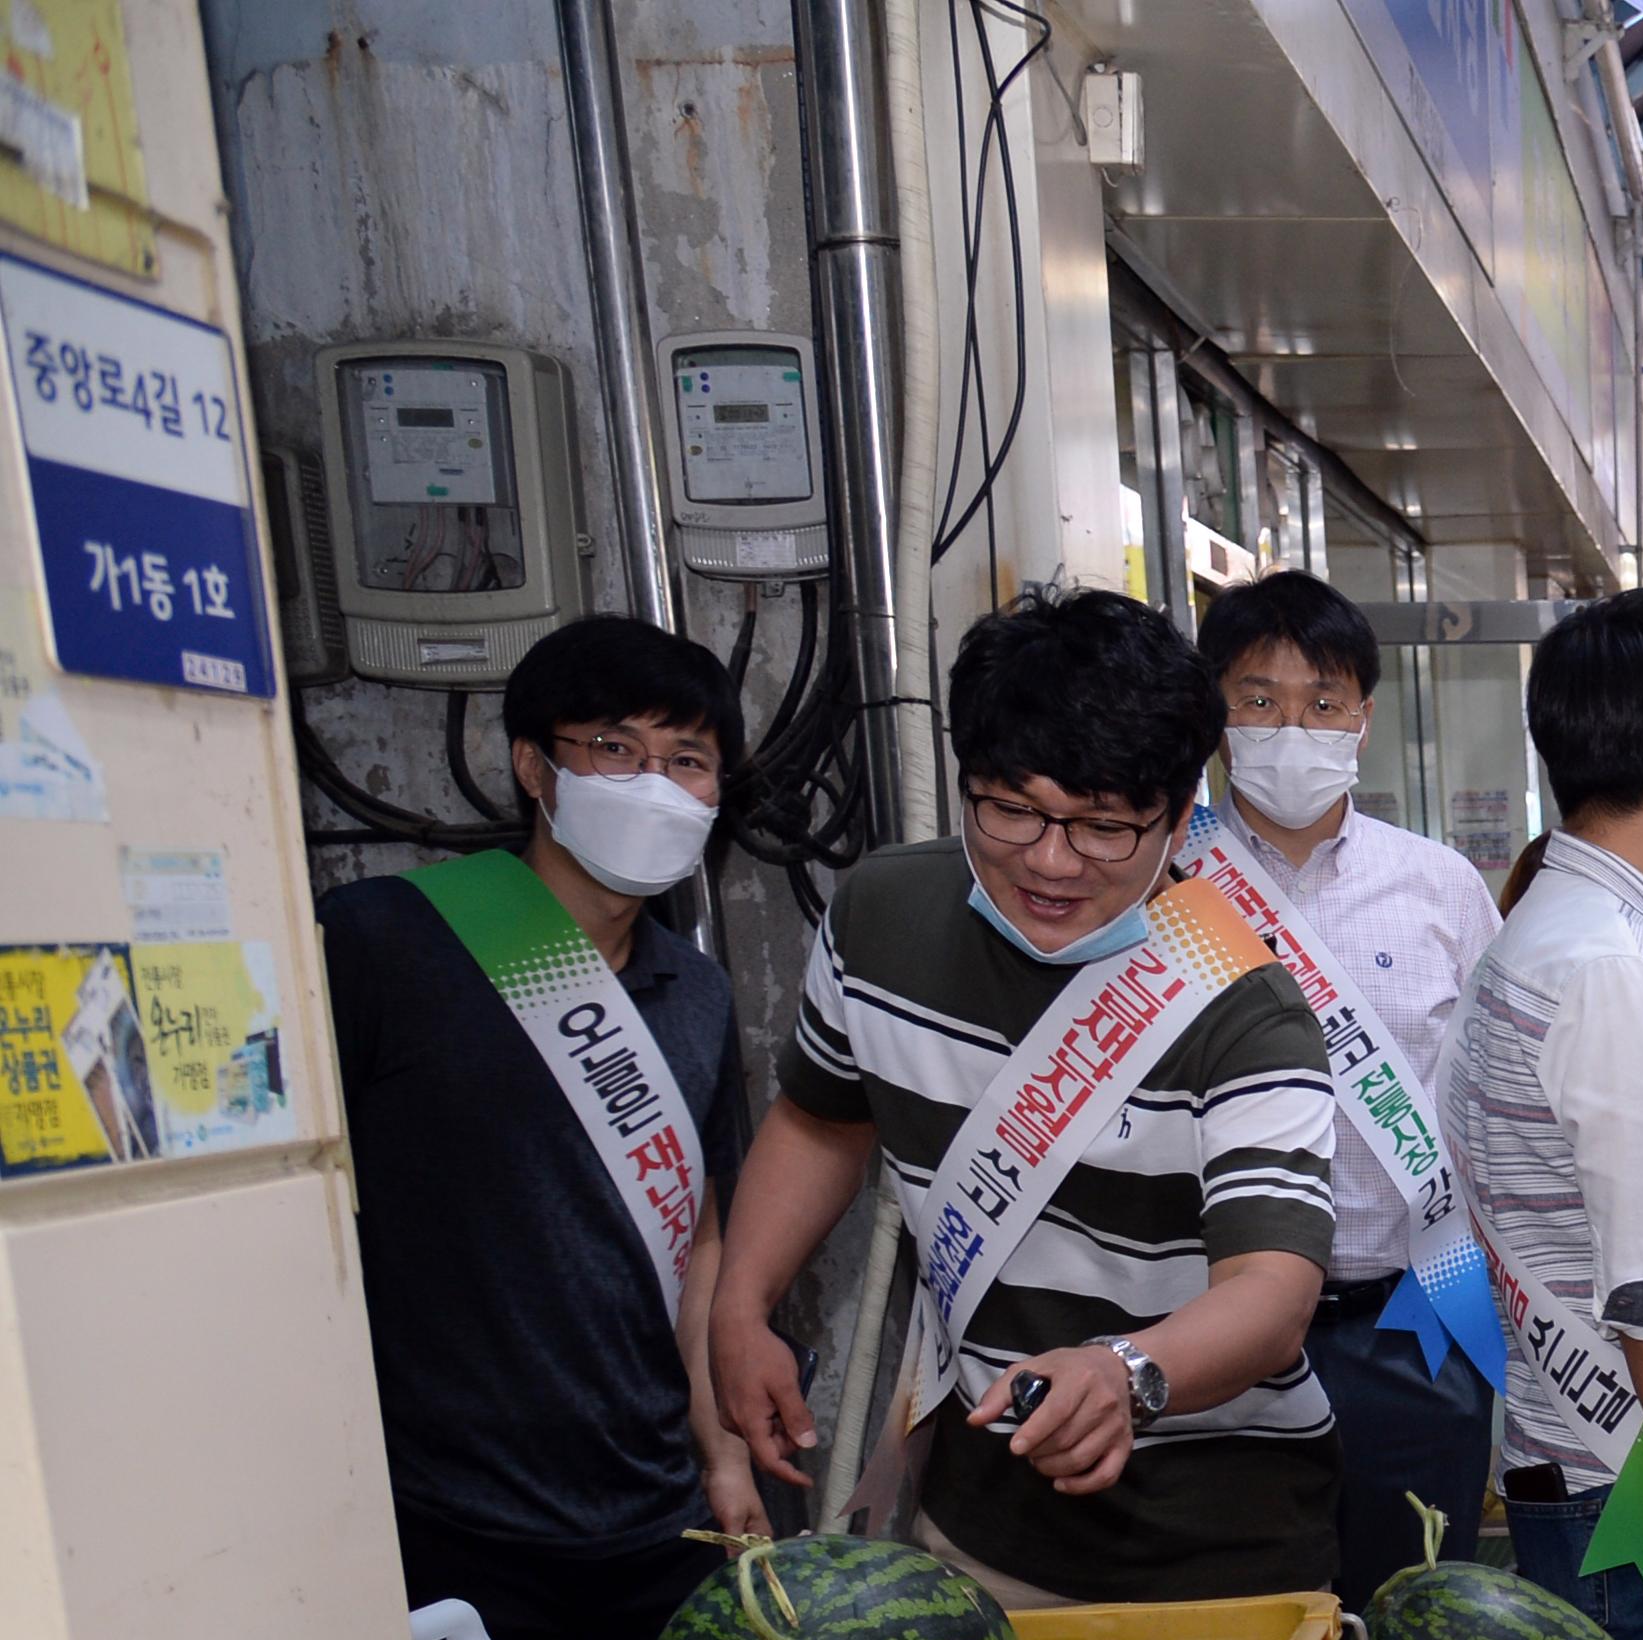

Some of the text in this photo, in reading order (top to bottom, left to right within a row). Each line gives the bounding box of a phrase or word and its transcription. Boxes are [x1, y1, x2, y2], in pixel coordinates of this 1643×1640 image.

[24, 329, 232, 442] 중앙로4길 12
[83, 540, 237, 622] 가1동 1호
[557, 1000, 664, 1139] 오늘은
[995, 947, 1187, 1169] 긴급재난지원금
[956, 1147, 1025, 1227] 쓰고
[1350, 1061, 1440, 1178] 전통시장
[1418, 1165, 1457, 1233] 가요
[1527, 1313, 1640, 1435] 쓰는날
